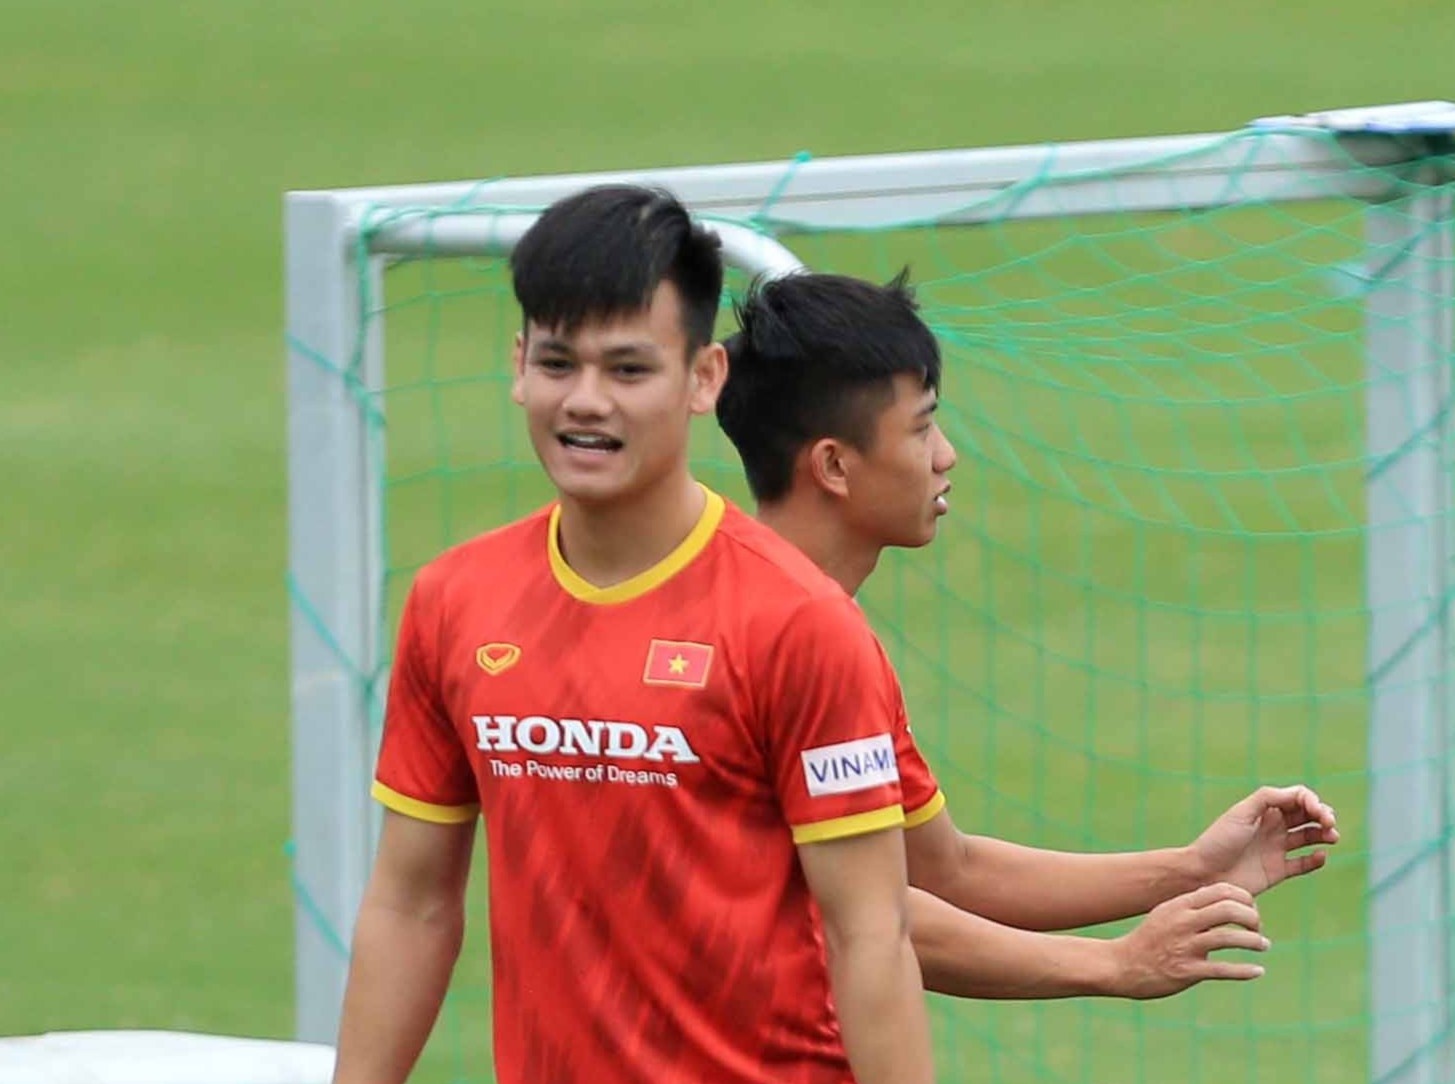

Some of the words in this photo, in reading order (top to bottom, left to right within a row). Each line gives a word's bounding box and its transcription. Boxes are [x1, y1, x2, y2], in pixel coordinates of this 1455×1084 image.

[472, 715, 700, 763] HONDA
[490, 759, 522, 777] The
[526, 761, 581, 780] Power
[585, 763, 603, 780] of
[607, 765, 679, 788] Dreams
